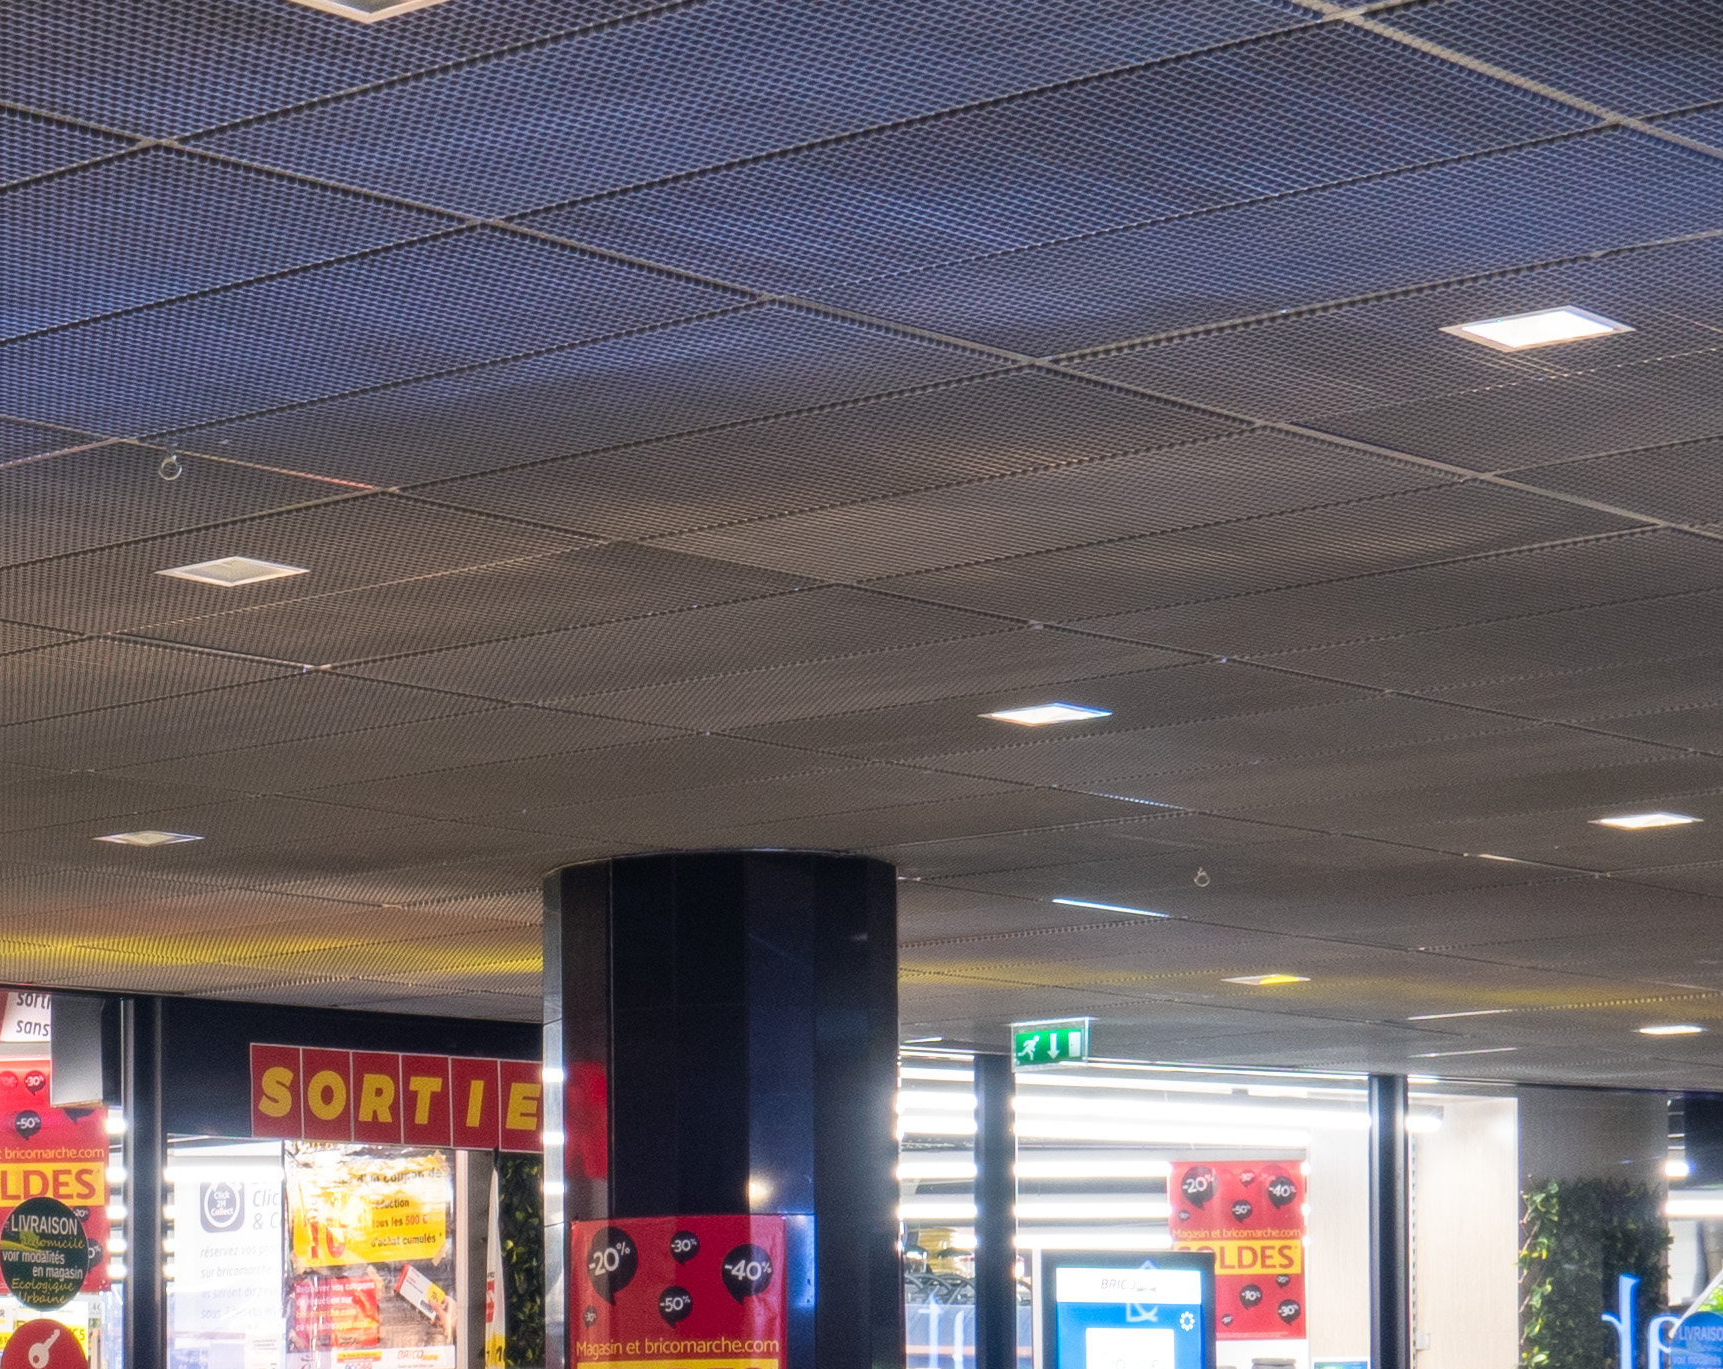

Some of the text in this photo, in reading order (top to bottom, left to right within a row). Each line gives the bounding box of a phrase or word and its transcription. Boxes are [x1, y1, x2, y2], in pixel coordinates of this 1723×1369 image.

[16, 1020, 51, 1037] sans
[25, 1075, 45, 1087] -30%
[257, 1066, 543, 1131] SORTIE
[16, 1117, 40, 1129] -50%
[6, 1147, 104, 1160] bricomarche.com
[1182, 1175, 1214, 1194] -20%
[1269, 1184, 1296, 1197] -40%
[213, 1190, 230, 1200] Click
[210, 1206, 234, 1217] Collect
[11, 1214, 78, 1235] LIVRAISON
[391, 1217, 403, 1227] les
[405, 1215, 420, 1226] 500
[402, 1233, 436, 1244] cumulés
[1173, 1228, 1301, 1241] Magasin et bricomarche.com
[670, 1237, 697, 1253] -30%
[2, 1248, 65, 1265] voir modalités
[200, 1246, 238, 1258] réservez
[588, 1241, 631, 1276] -20%
[32, 1265, 83, 1281] en magasin
[200, 1268, 215, 1279] sur
[724, 1259, 773, 1282] -40%
[1241, 1290, 1261, 1300] -10%
[659, 1294, 691, 1312] -50%
[1278, 1304, 1299, 1316] -30%
[577, 1336, 779, 1360] Magasin et bricomarche.com
